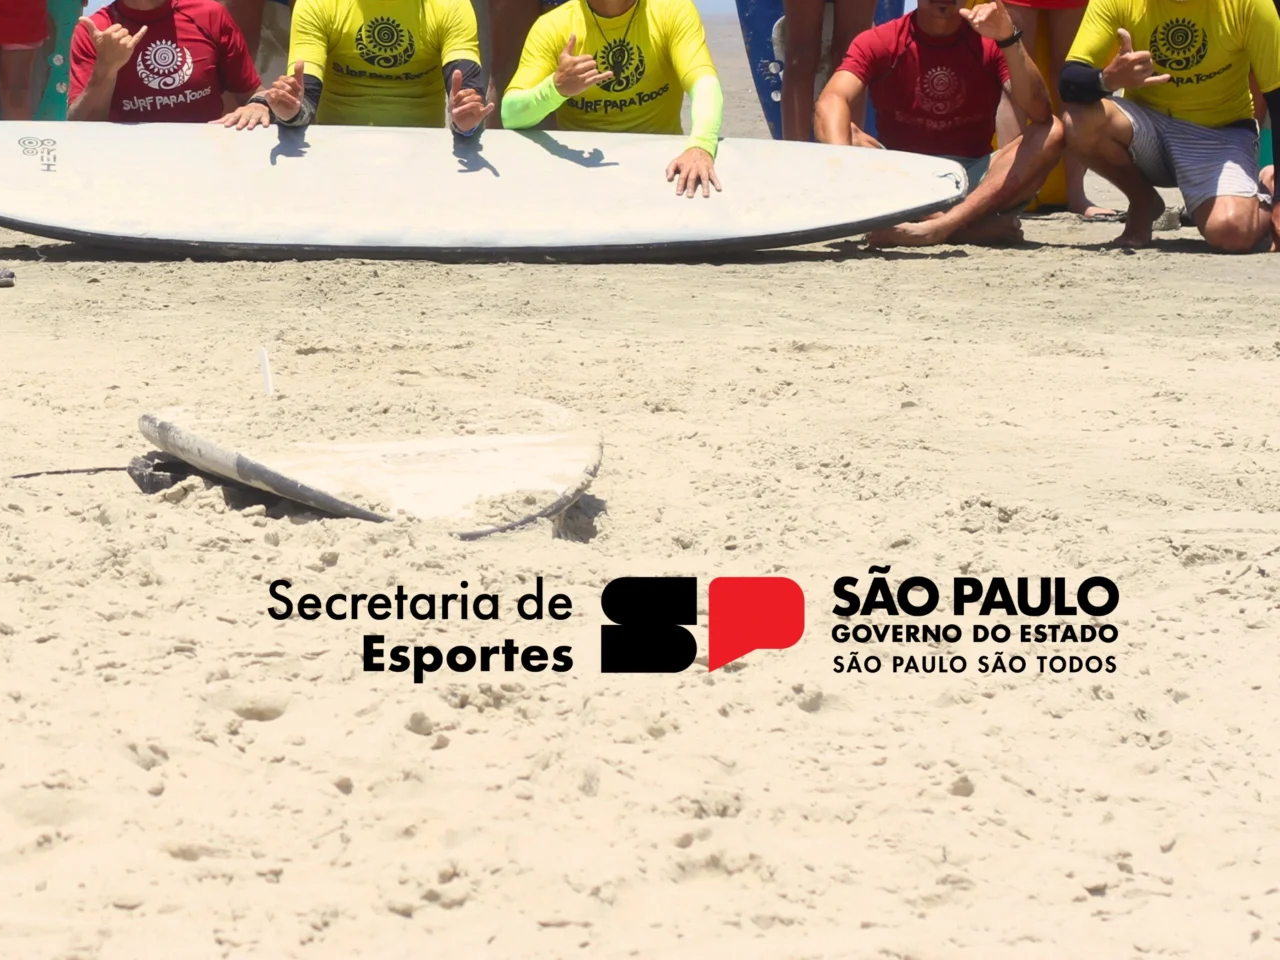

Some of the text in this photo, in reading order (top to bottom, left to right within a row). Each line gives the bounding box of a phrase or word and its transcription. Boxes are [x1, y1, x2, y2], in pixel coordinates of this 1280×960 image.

[122, 96, 154, 113] SURF
[155, 93, 186, 111] PARA
[567, 97, 603, 115] SURF
[603, 97, 637, 115] PARA
